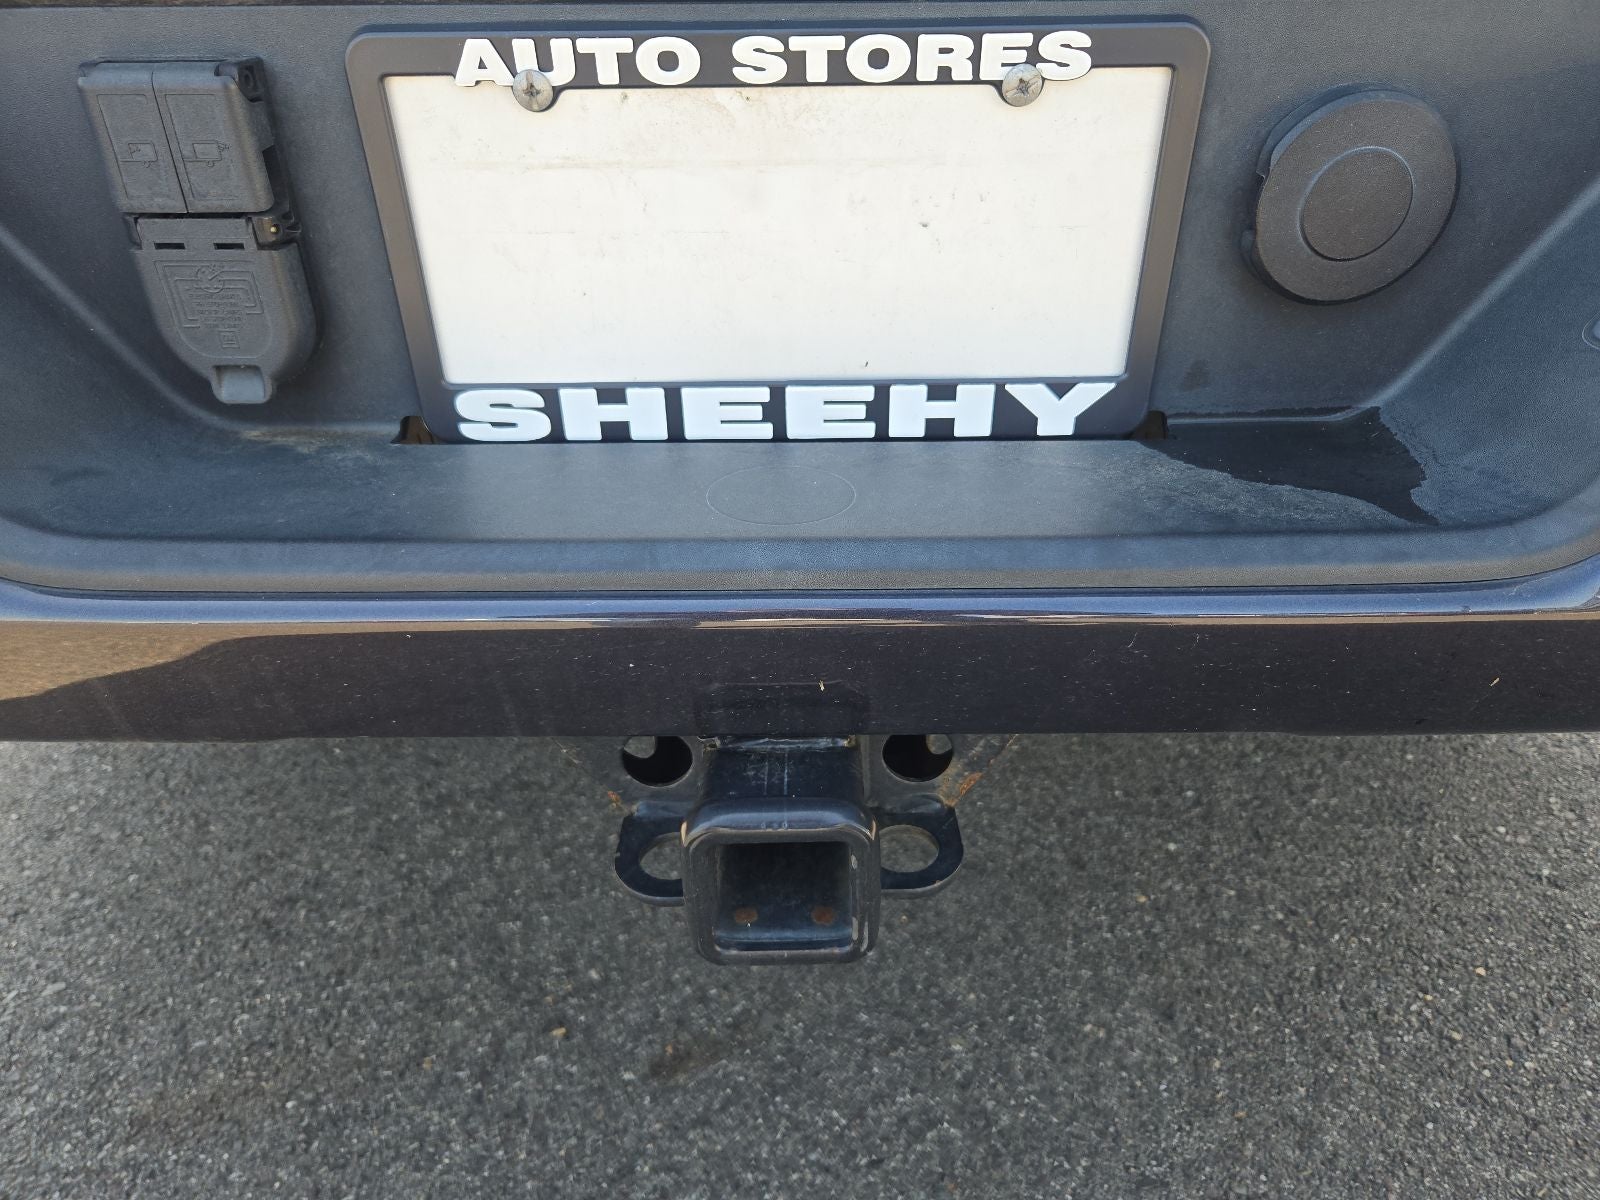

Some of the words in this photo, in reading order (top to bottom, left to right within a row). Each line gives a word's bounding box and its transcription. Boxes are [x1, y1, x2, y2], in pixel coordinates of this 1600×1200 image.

[454, 36, 701, 88] AUTO
[731, 30, 1093, 84] STORES
[454, 382, 1117, 442] SHEEHY
